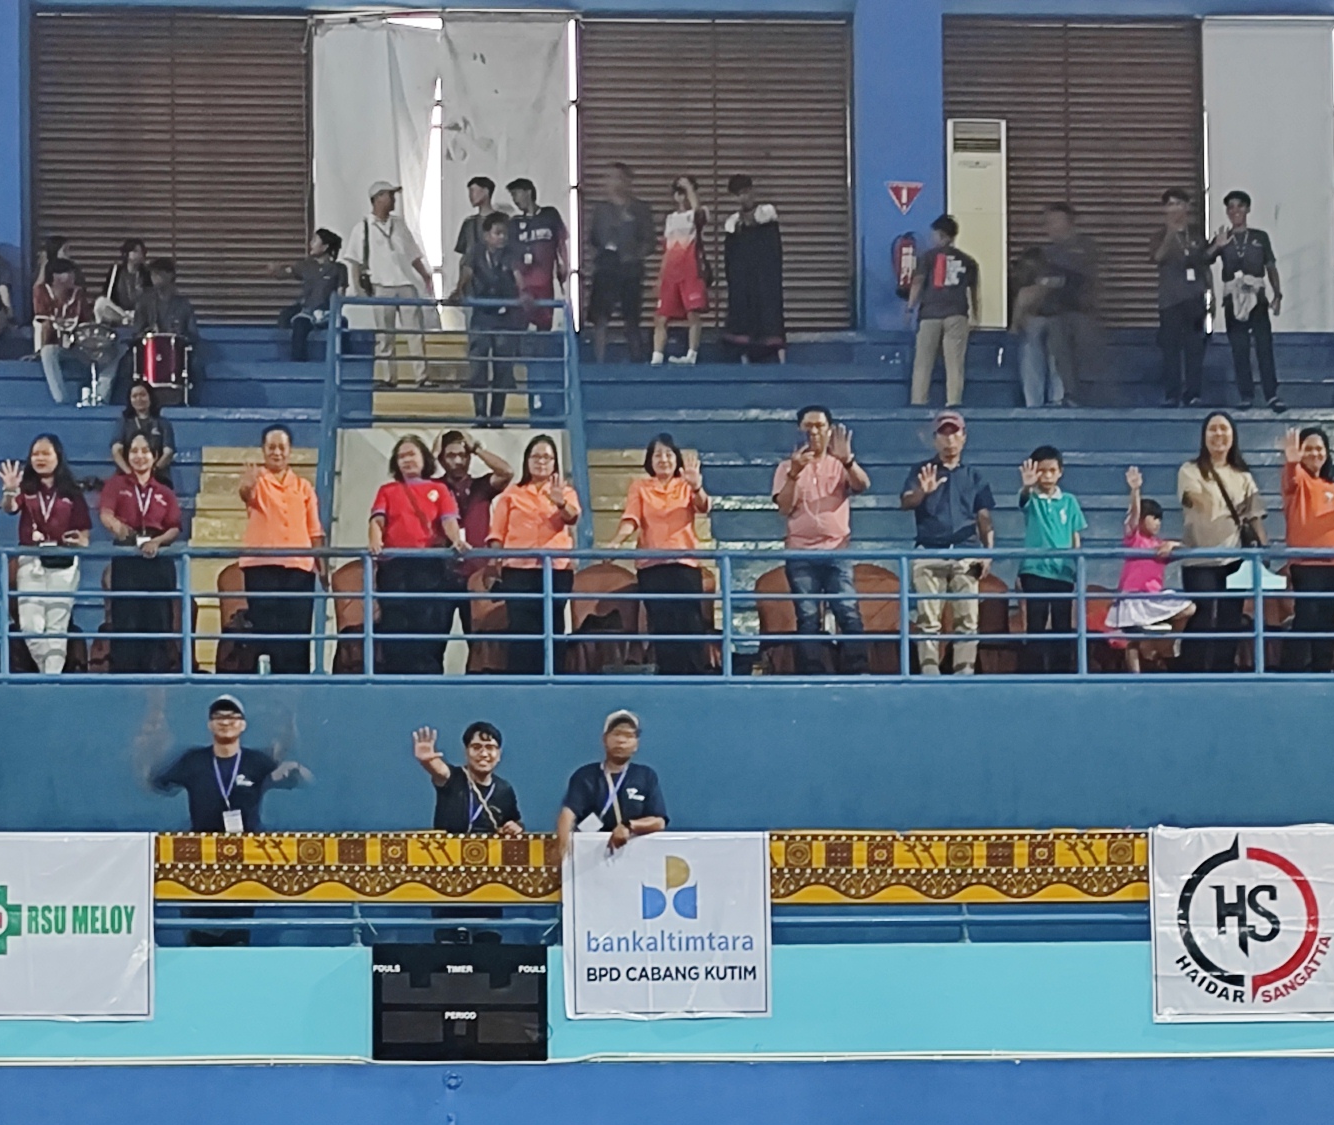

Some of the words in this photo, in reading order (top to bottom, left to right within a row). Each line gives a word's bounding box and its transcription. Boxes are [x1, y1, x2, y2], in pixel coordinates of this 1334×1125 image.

[27, 905, 66, 934] RSU
[72, 905, 135, 934] MELOY
[1208, 884, 1281, 958] HS
[586, 930, 754, 952] bankaltimtara
[372, 964, 401, 973] FOULS
[446, 965, 473, 974] TIMER
[518, 965, 546, 973] FOULS
[587, 967, 621, 982] BPD
[625, 966, 700, 981] CABANG
[705, 966, 757, 980] KUTIM
[1175, 955, 1245, 1003] HAIDAR
[1261, 936, 1332, 1003] SANGATTA
